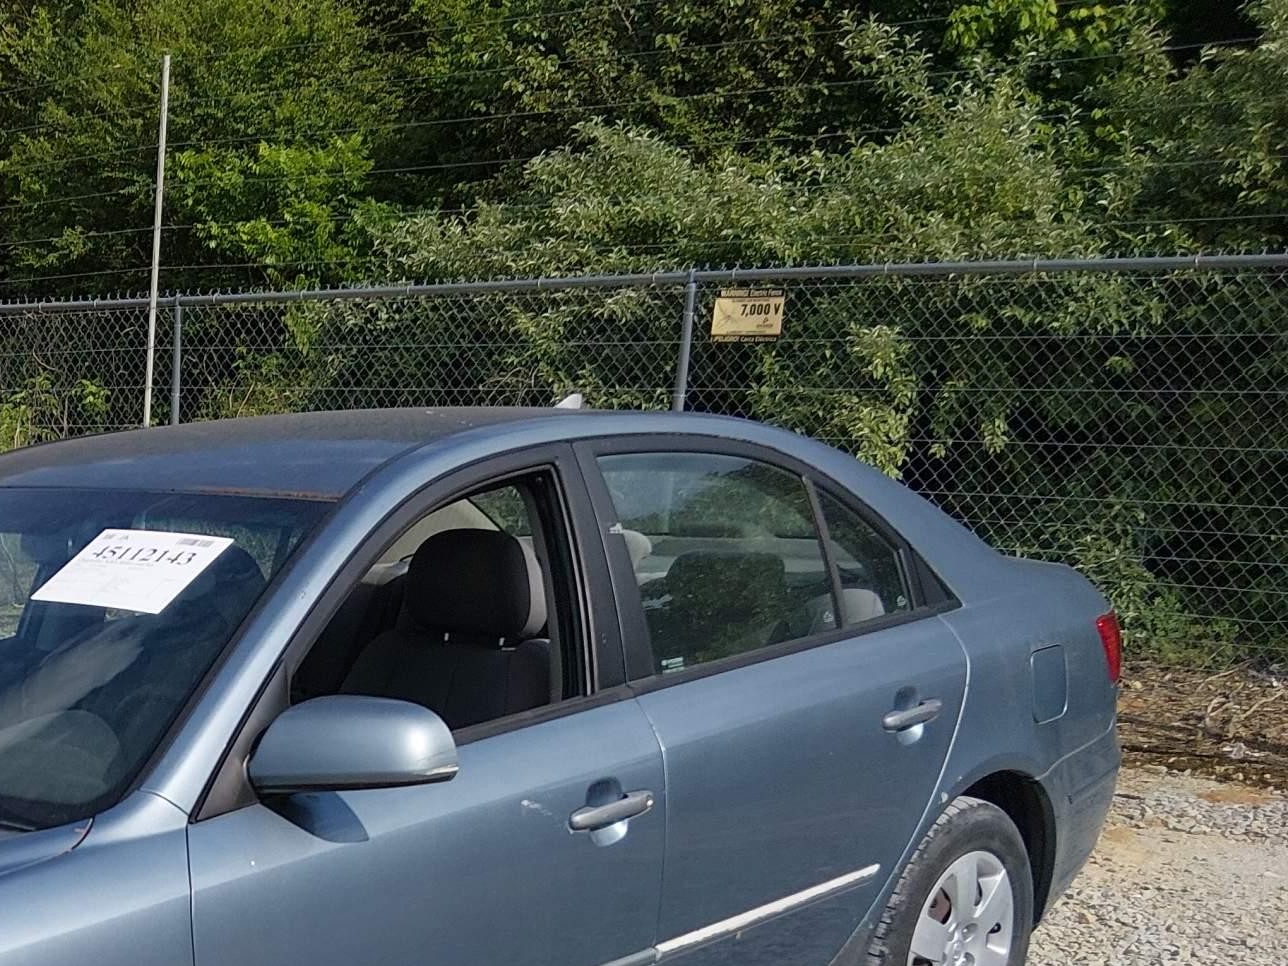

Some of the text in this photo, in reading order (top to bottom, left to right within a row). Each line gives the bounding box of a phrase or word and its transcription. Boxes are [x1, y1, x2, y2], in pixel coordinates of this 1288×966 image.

[740, 303, 781, 317] 7,000 V
[92, 545, 197, 565] 45112143
